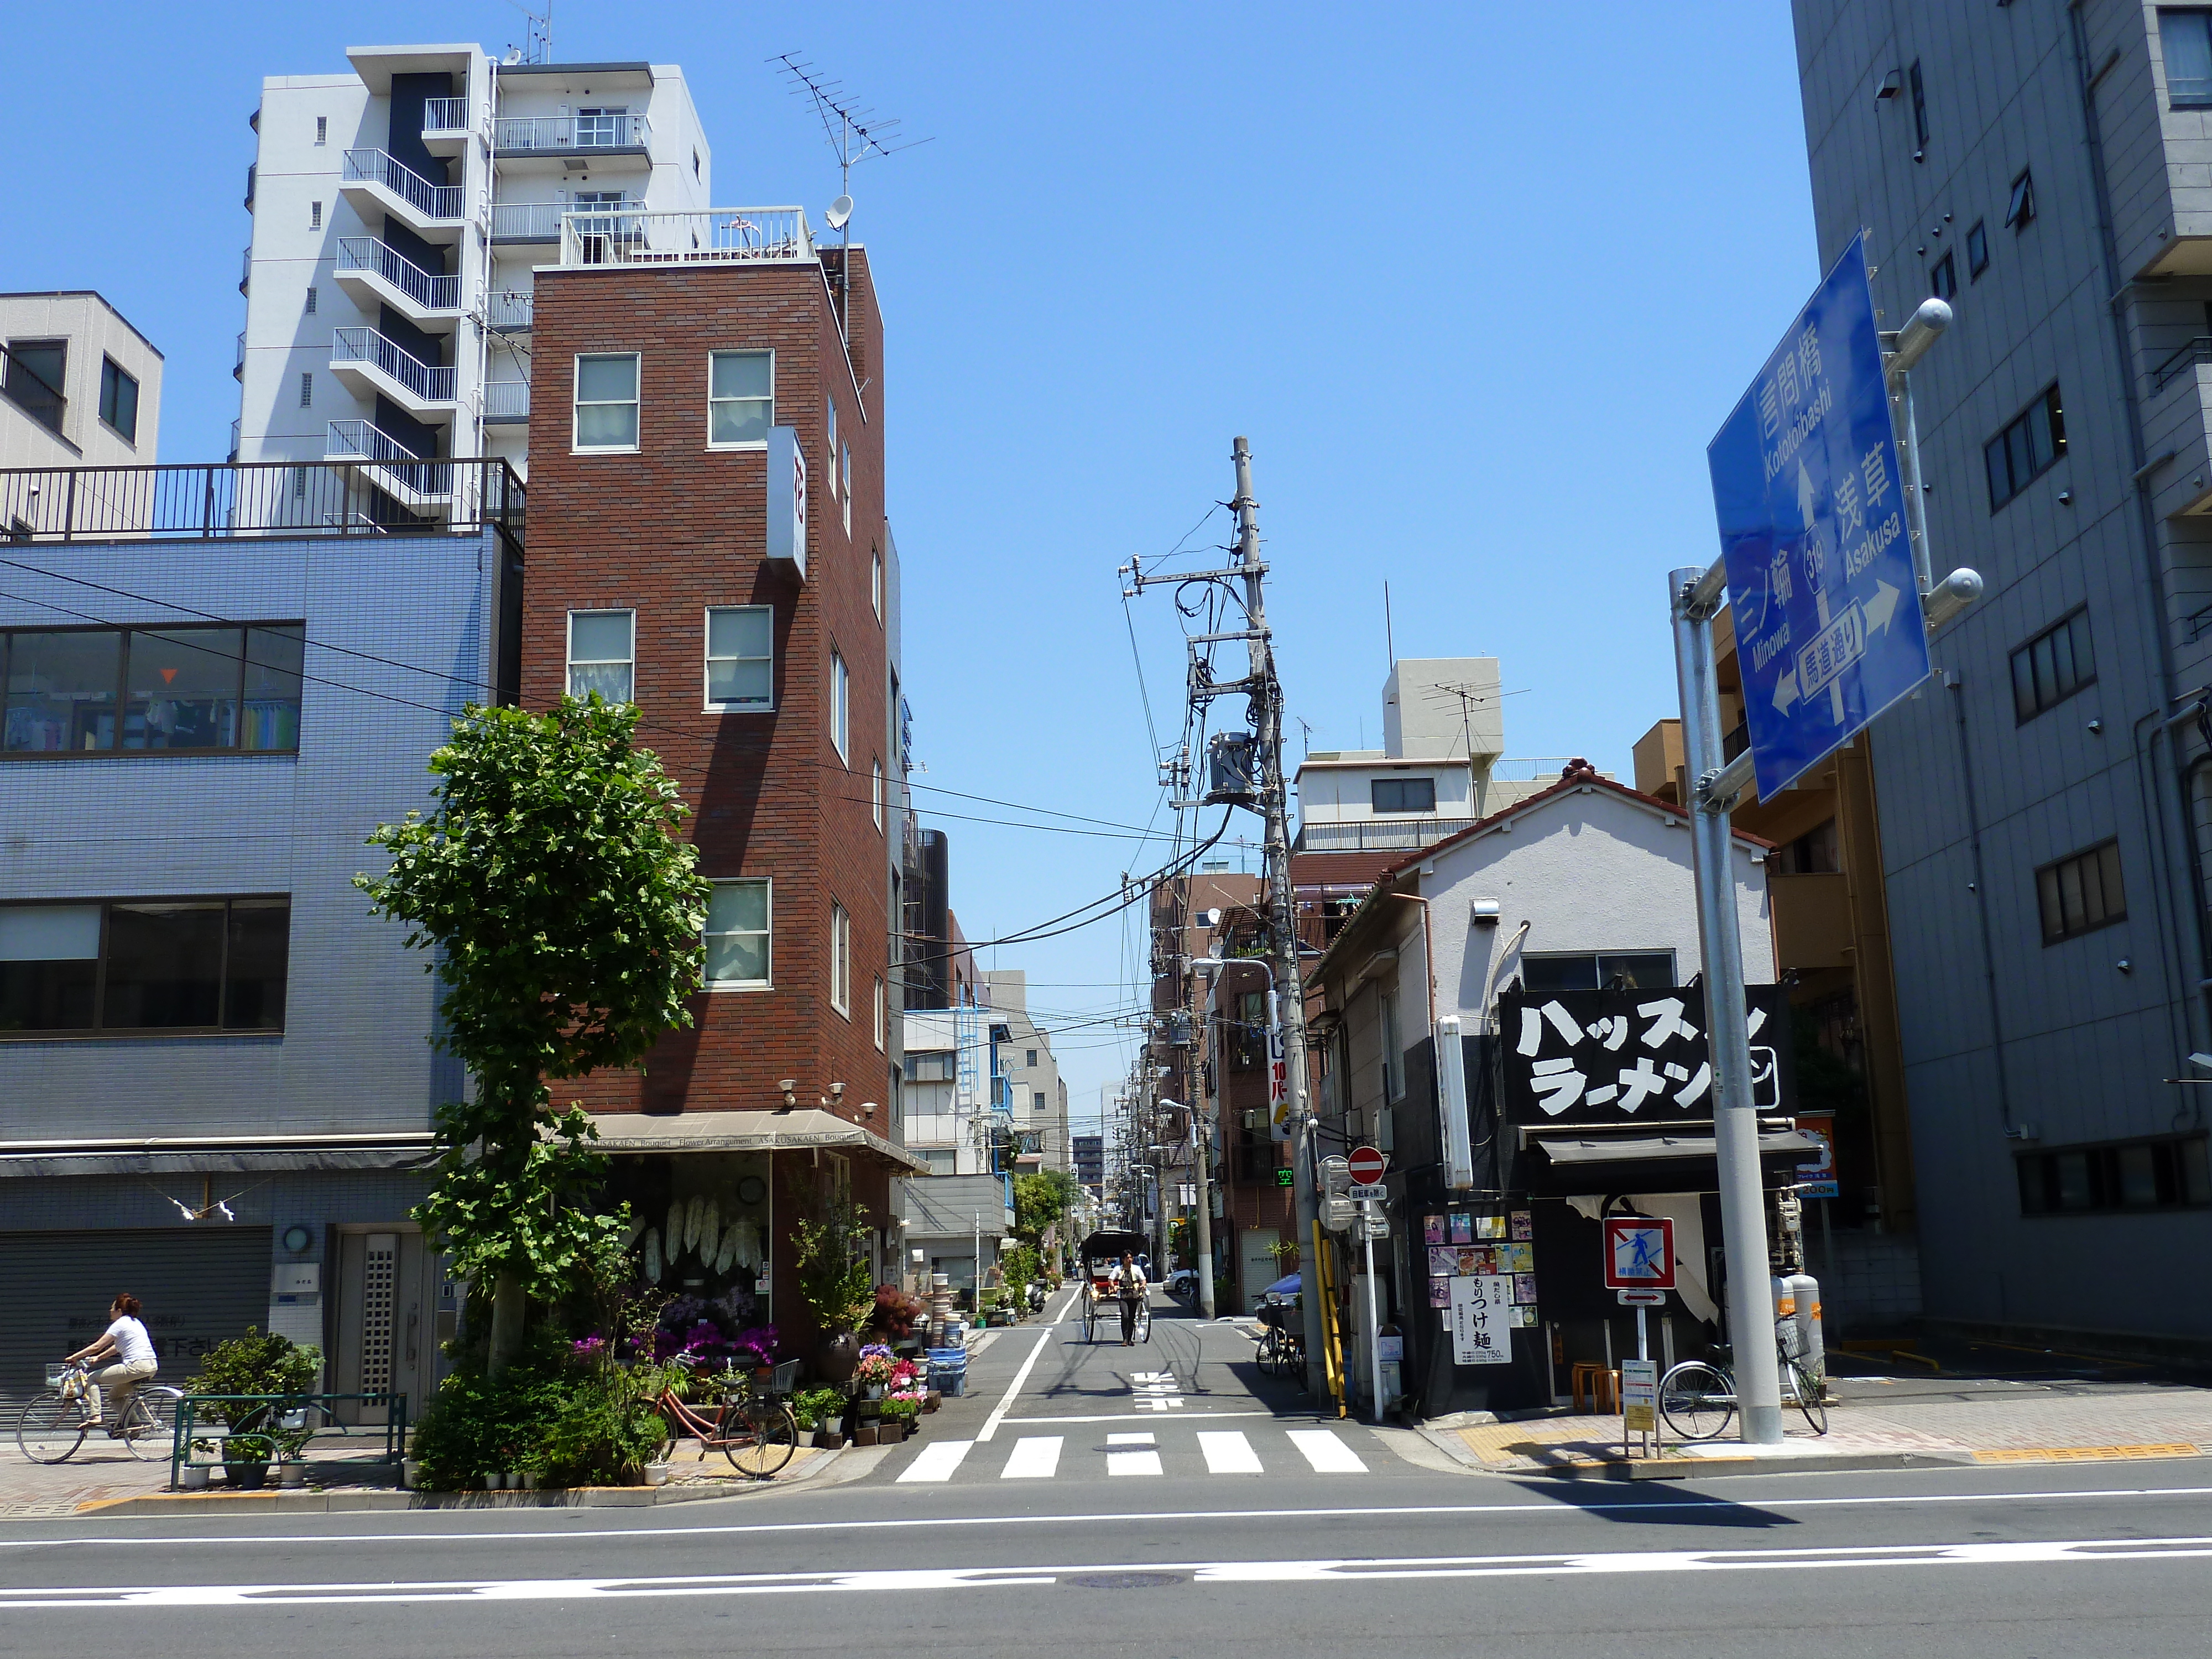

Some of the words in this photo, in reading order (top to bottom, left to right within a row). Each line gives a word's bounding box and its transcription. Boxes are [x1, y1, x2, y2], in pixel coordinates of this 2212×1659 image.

[1760, 321, 1822, 440] 言問橋
[1765, 378, 1832, 482] Kototoibashi
[1835, 441, 1890, 544] 浅草
[1806, 540, 1823, 578] 319
[1845, 512, 1901, 583] Asakusa
[1737, 549, 1793, 645] 三ノ輪
[1752, 622, 1790, 674] Minowa
[1805, 615, 1855, 689] 馬道通り
[1530, 1057, 1712, 1116] ラーメン
[580, 1139, 635, 1148] SAKUSAKAEN
[640, 1139, 671, 1149] Bouquet
[679, 1138, 705, 1146] Flower
[705, 1138, 752, 1147] Arrangement
[758, 1135, 820, 1144] ASAKUSAKAEN
[825, 1133, 855, 1142] Bouquet
[1278, 1170, 1292, 1185] 空
[1353, 1189, 1384, 1198] 自転車を除く
[1802, 1186, 1834, 1194] 200円
[1618, 1267, 1651, 1277] 横断禁止
[1470, 1277, 1492, 1350] もりつけ麺
